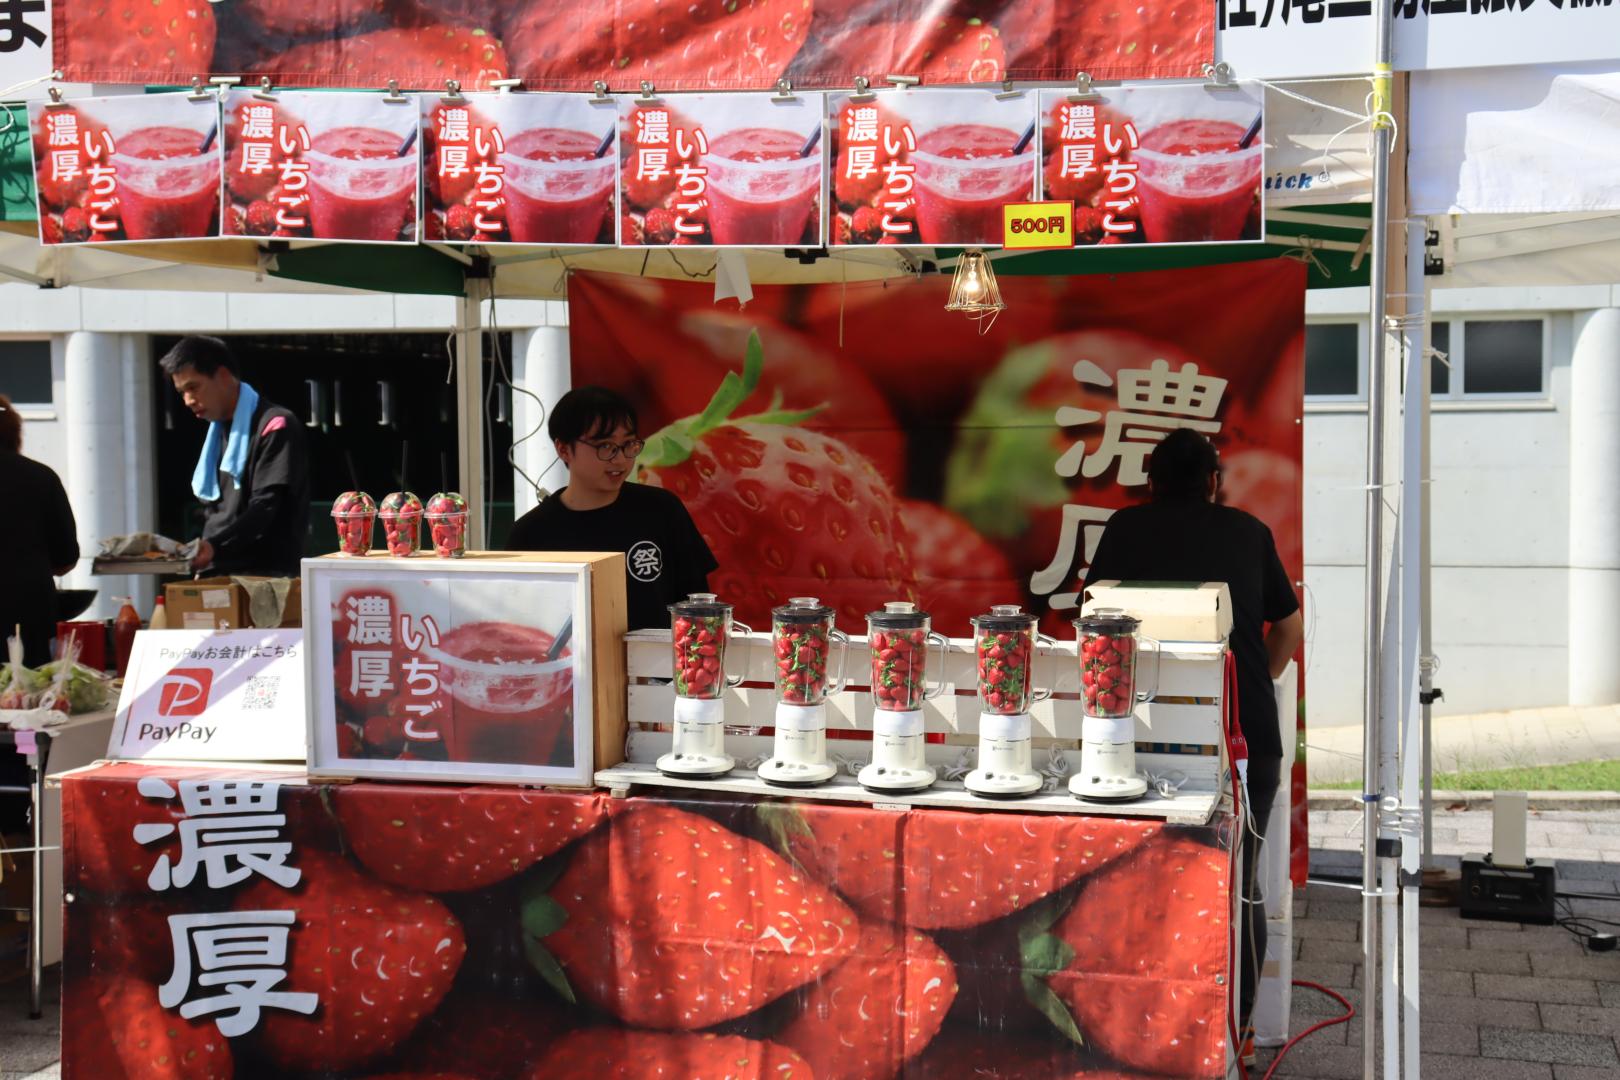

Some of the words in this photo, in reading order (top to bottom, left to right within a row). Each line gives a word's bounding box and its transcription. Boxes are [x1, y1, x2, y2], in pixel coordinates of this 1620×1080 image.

[46, 113, 82, 182] 濃厚
[240, 105, 275, 175] 濃厚
[276, 124, 311, 229] いちご
[437, 109, 471, 179] 濃厚
[635, 107, 671, 182] 濃厚
[845, 107, 879, 181] 濃厚
[1059, 105, 1097, 180] 濃厚
[1102, 122, 1140, 232] いちご
[84, 130, 118, 232] いちご
[472, 125, 504, 232] いちご
[674, 127, 709, 234] いちご
[881, 124, 917, 233] いちご
[1011, 216, 1065, 233] 500円
[631, 546, 660, 577] 祭
[160, 644, 297, 660] PayPayお会計はこちら
[346, 595, 394, 697] 濃厚
[401, 614, 443, 740] いちご
[138, 722, 217, 743] PayPay
[133, 777, 319, 1037] 濃厚
